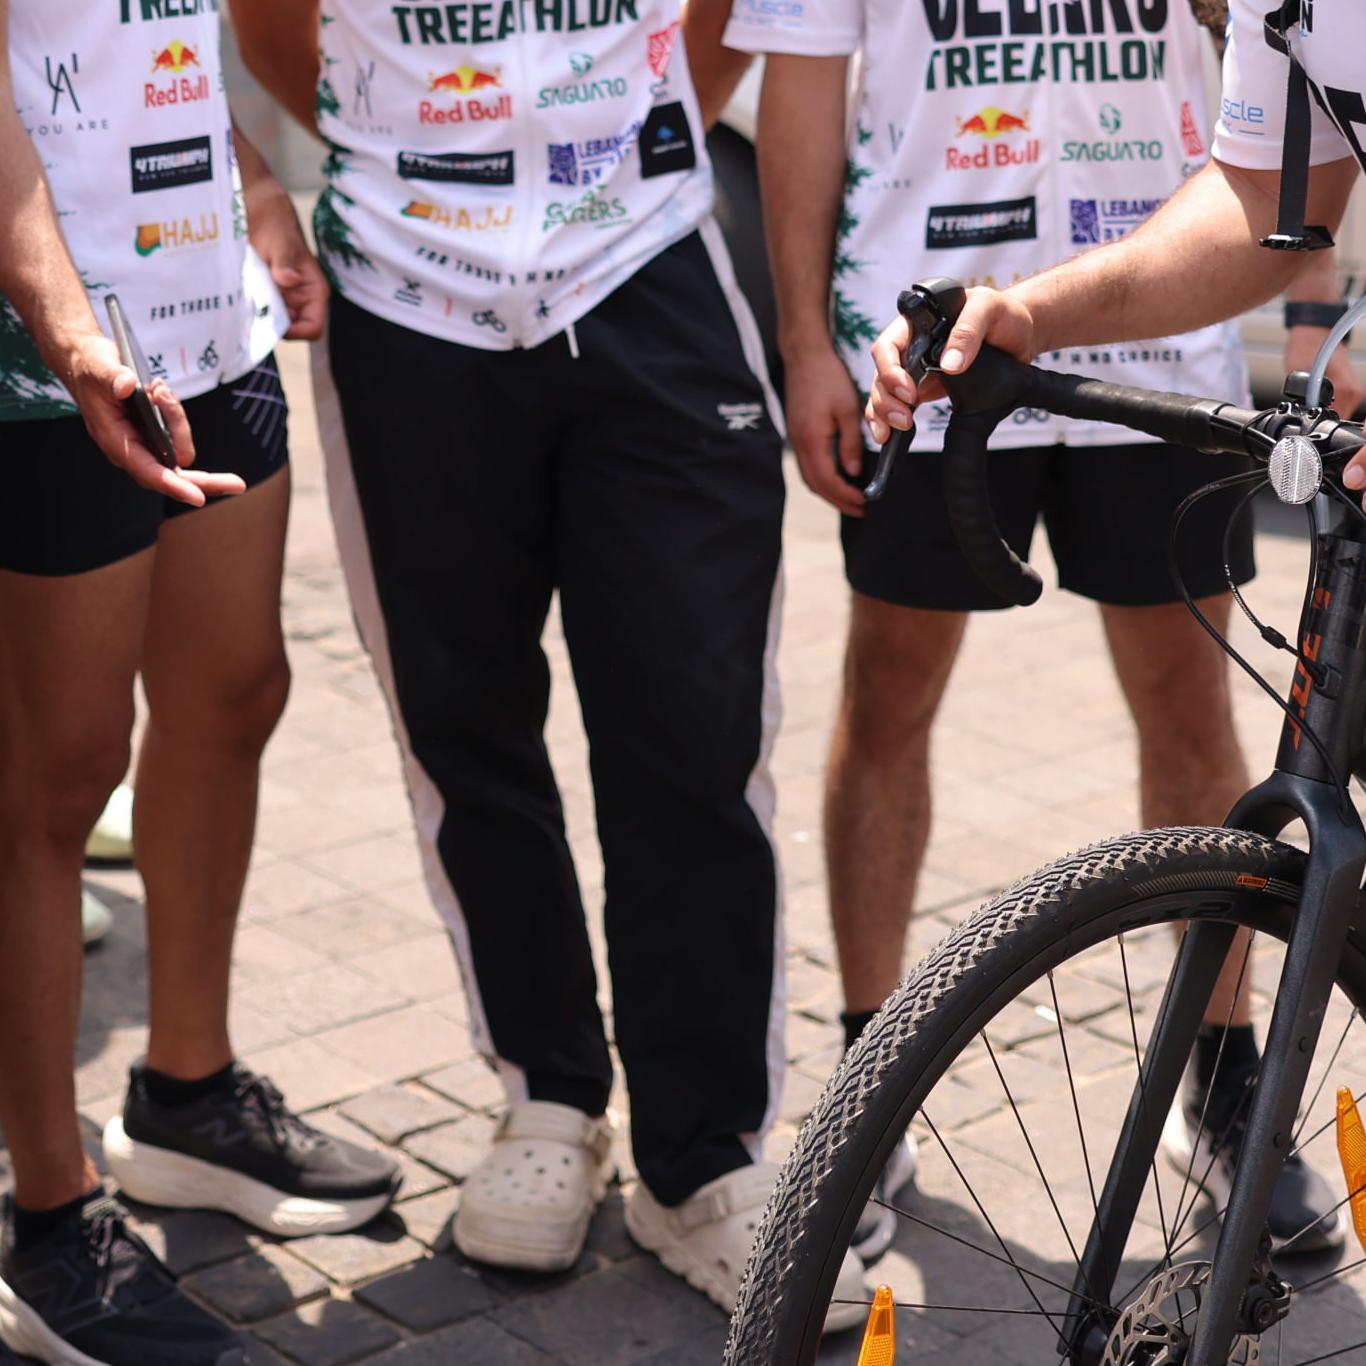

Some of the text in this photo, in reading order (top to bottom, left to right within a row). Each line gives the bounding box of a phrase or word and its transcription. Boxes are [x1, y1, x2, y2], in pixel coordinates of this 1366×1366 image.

[144, 74, 210, 109] Red Bull
[535, 76, 628, 109] SAGUARO
[76, 119, 110, 133] ARE
[418, 95, 513, 126] Red Bull
[946, 139, 1040, 171] Red Bull
[1059, 140, 1164, 162] SAGUARO
[162, 211, 219, 249] HAJJ
[150, 303, 176, 321] FOR
[181, 294, 221, 315] THOSE
[1119, 348, 1184, 363] CHOICE
